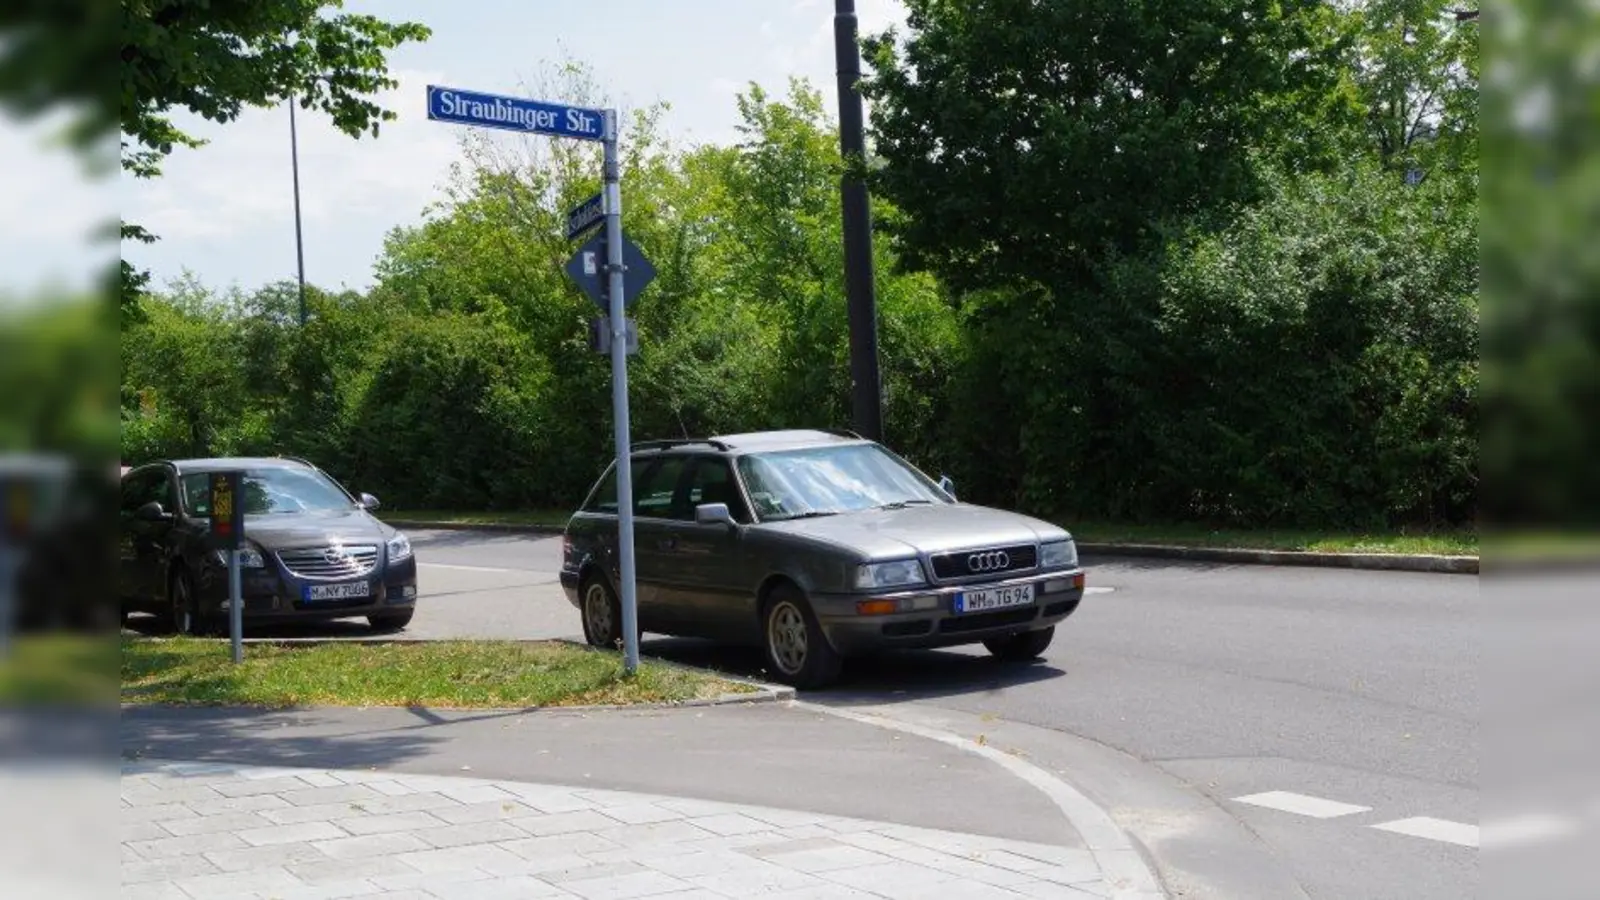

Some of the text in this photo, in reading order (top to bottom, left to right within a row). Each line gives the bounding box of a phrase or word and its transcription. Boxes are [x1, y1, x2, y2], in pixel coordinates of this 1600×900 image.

[440, 91, 597, 133] Straubinger Str.
[968, 586, 1030, 609] WM TG 94
